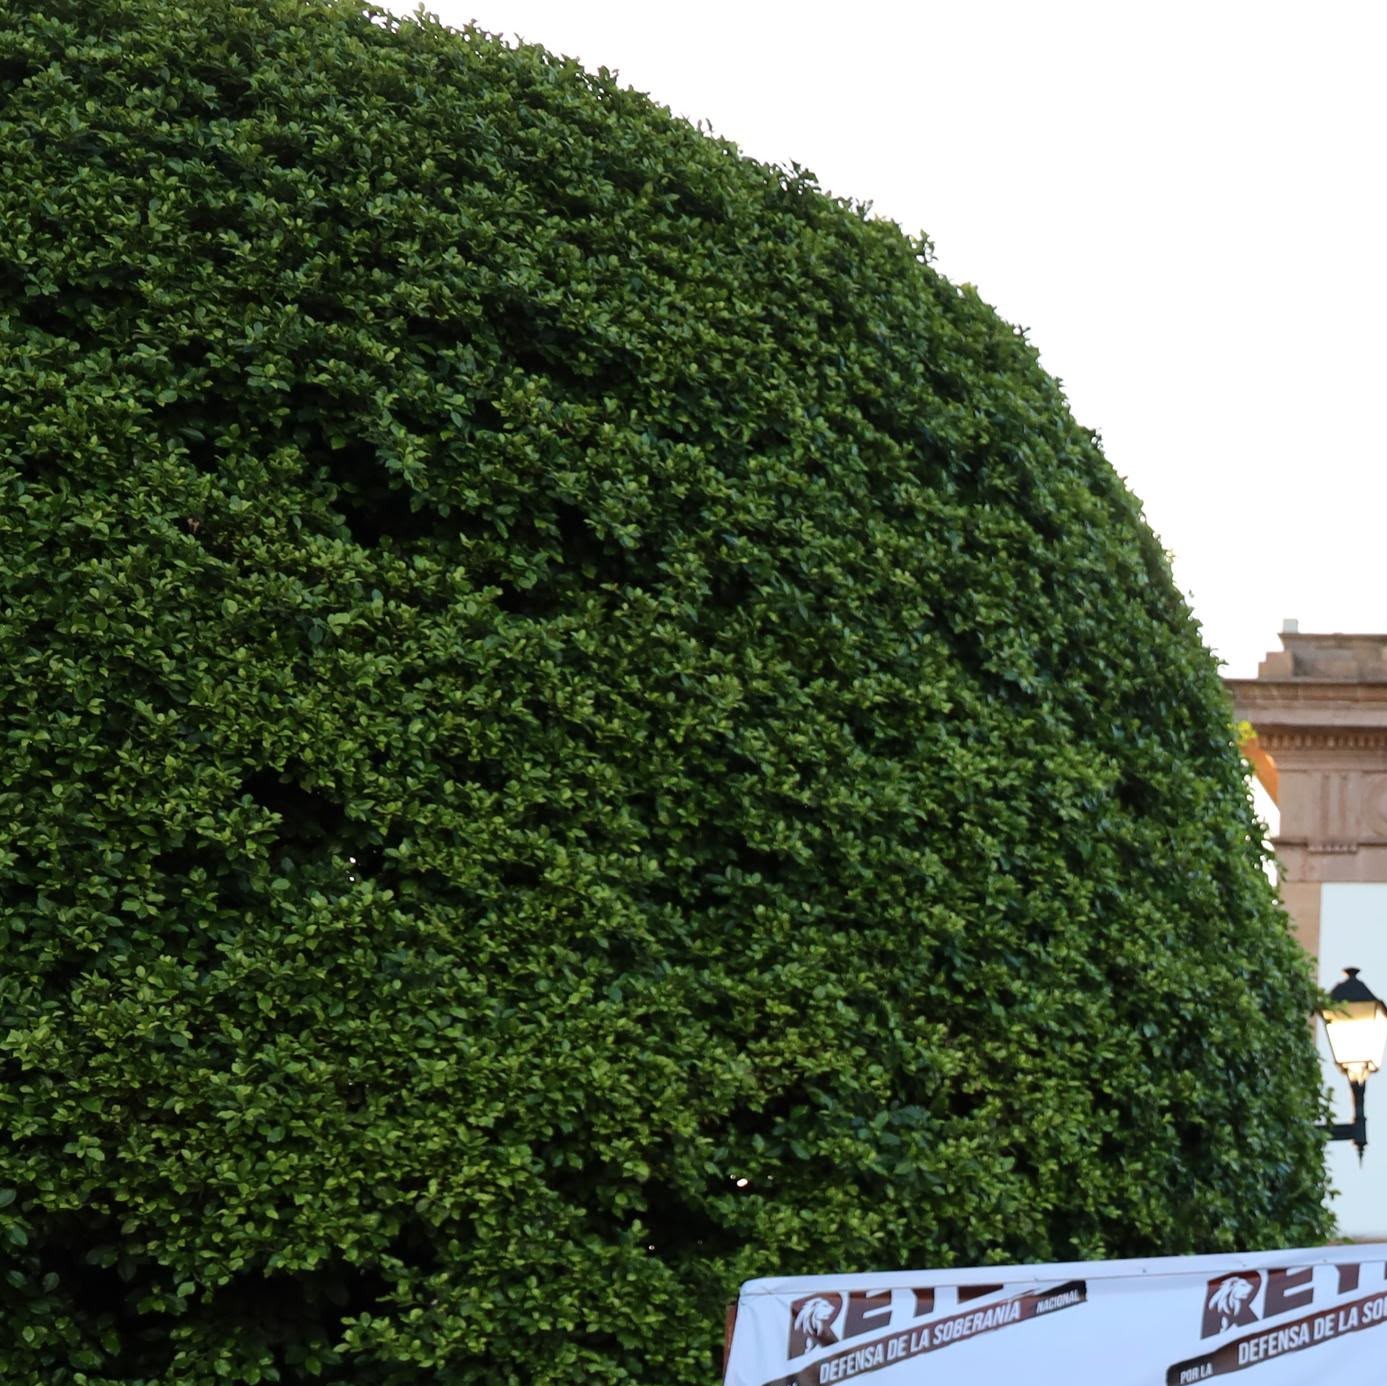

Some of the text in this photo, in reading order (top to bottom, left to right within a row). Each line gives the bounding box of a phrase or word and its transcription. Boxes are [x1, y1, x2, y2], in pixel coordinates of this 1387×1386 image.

[820, 1344, 883, 1384] DEFENSA
[887, 1337, 907, 1361] DE
[910, 1330, 929, 1353] LA
[934, 1299, 1021, 1345] SOBERANÍA
[1036, 1290, 1080, 1313] NACIONAL
[1180, 1367, 1200, 1386] POR
[1200, 1363, 1213, 1377] LA
[1238, 1323, 1310, 1365] DEFENSA
[1314, 1314, 1335, 1338] DE
[1339, 1308, 1358, 1332] LA
